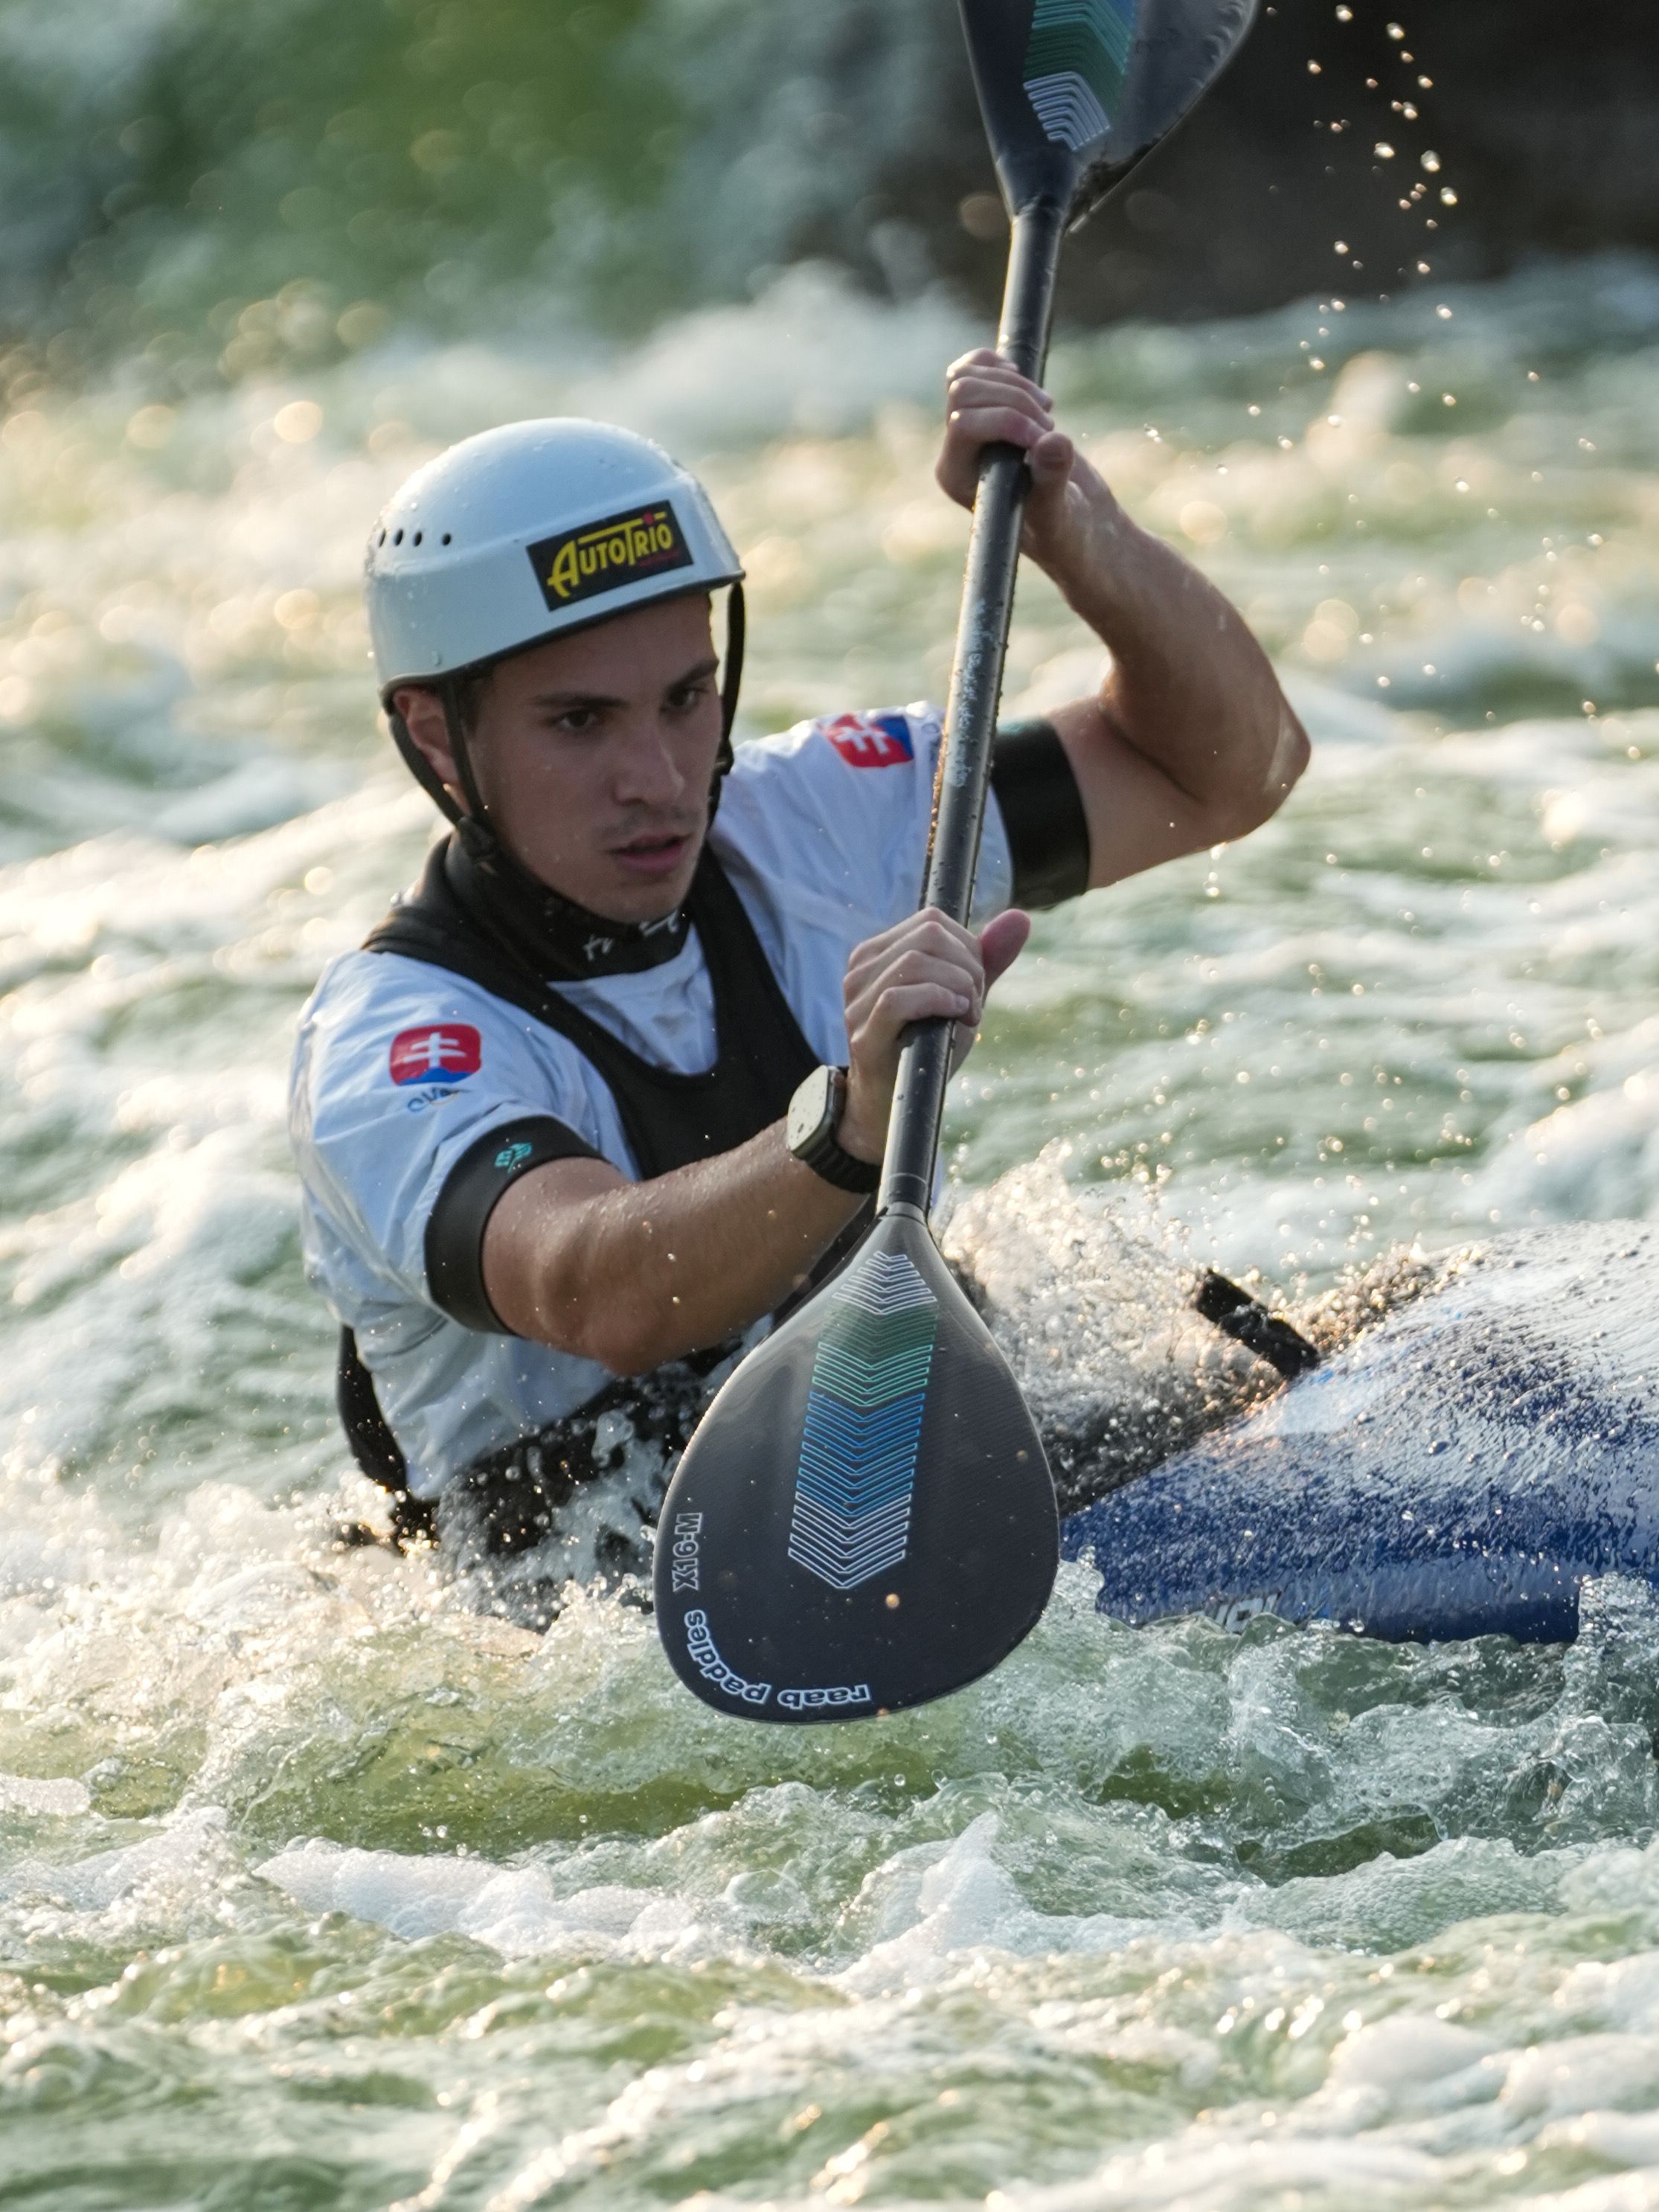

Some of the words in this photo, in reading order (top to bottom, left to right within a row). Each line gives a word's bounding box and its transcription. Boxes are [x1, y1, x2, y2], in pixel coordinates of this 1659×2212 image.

[672, 1513, 702, 1592] X16-M
[684, 1609, 771, 1704] paddles
[777, 1684, 870, 1710] raab
